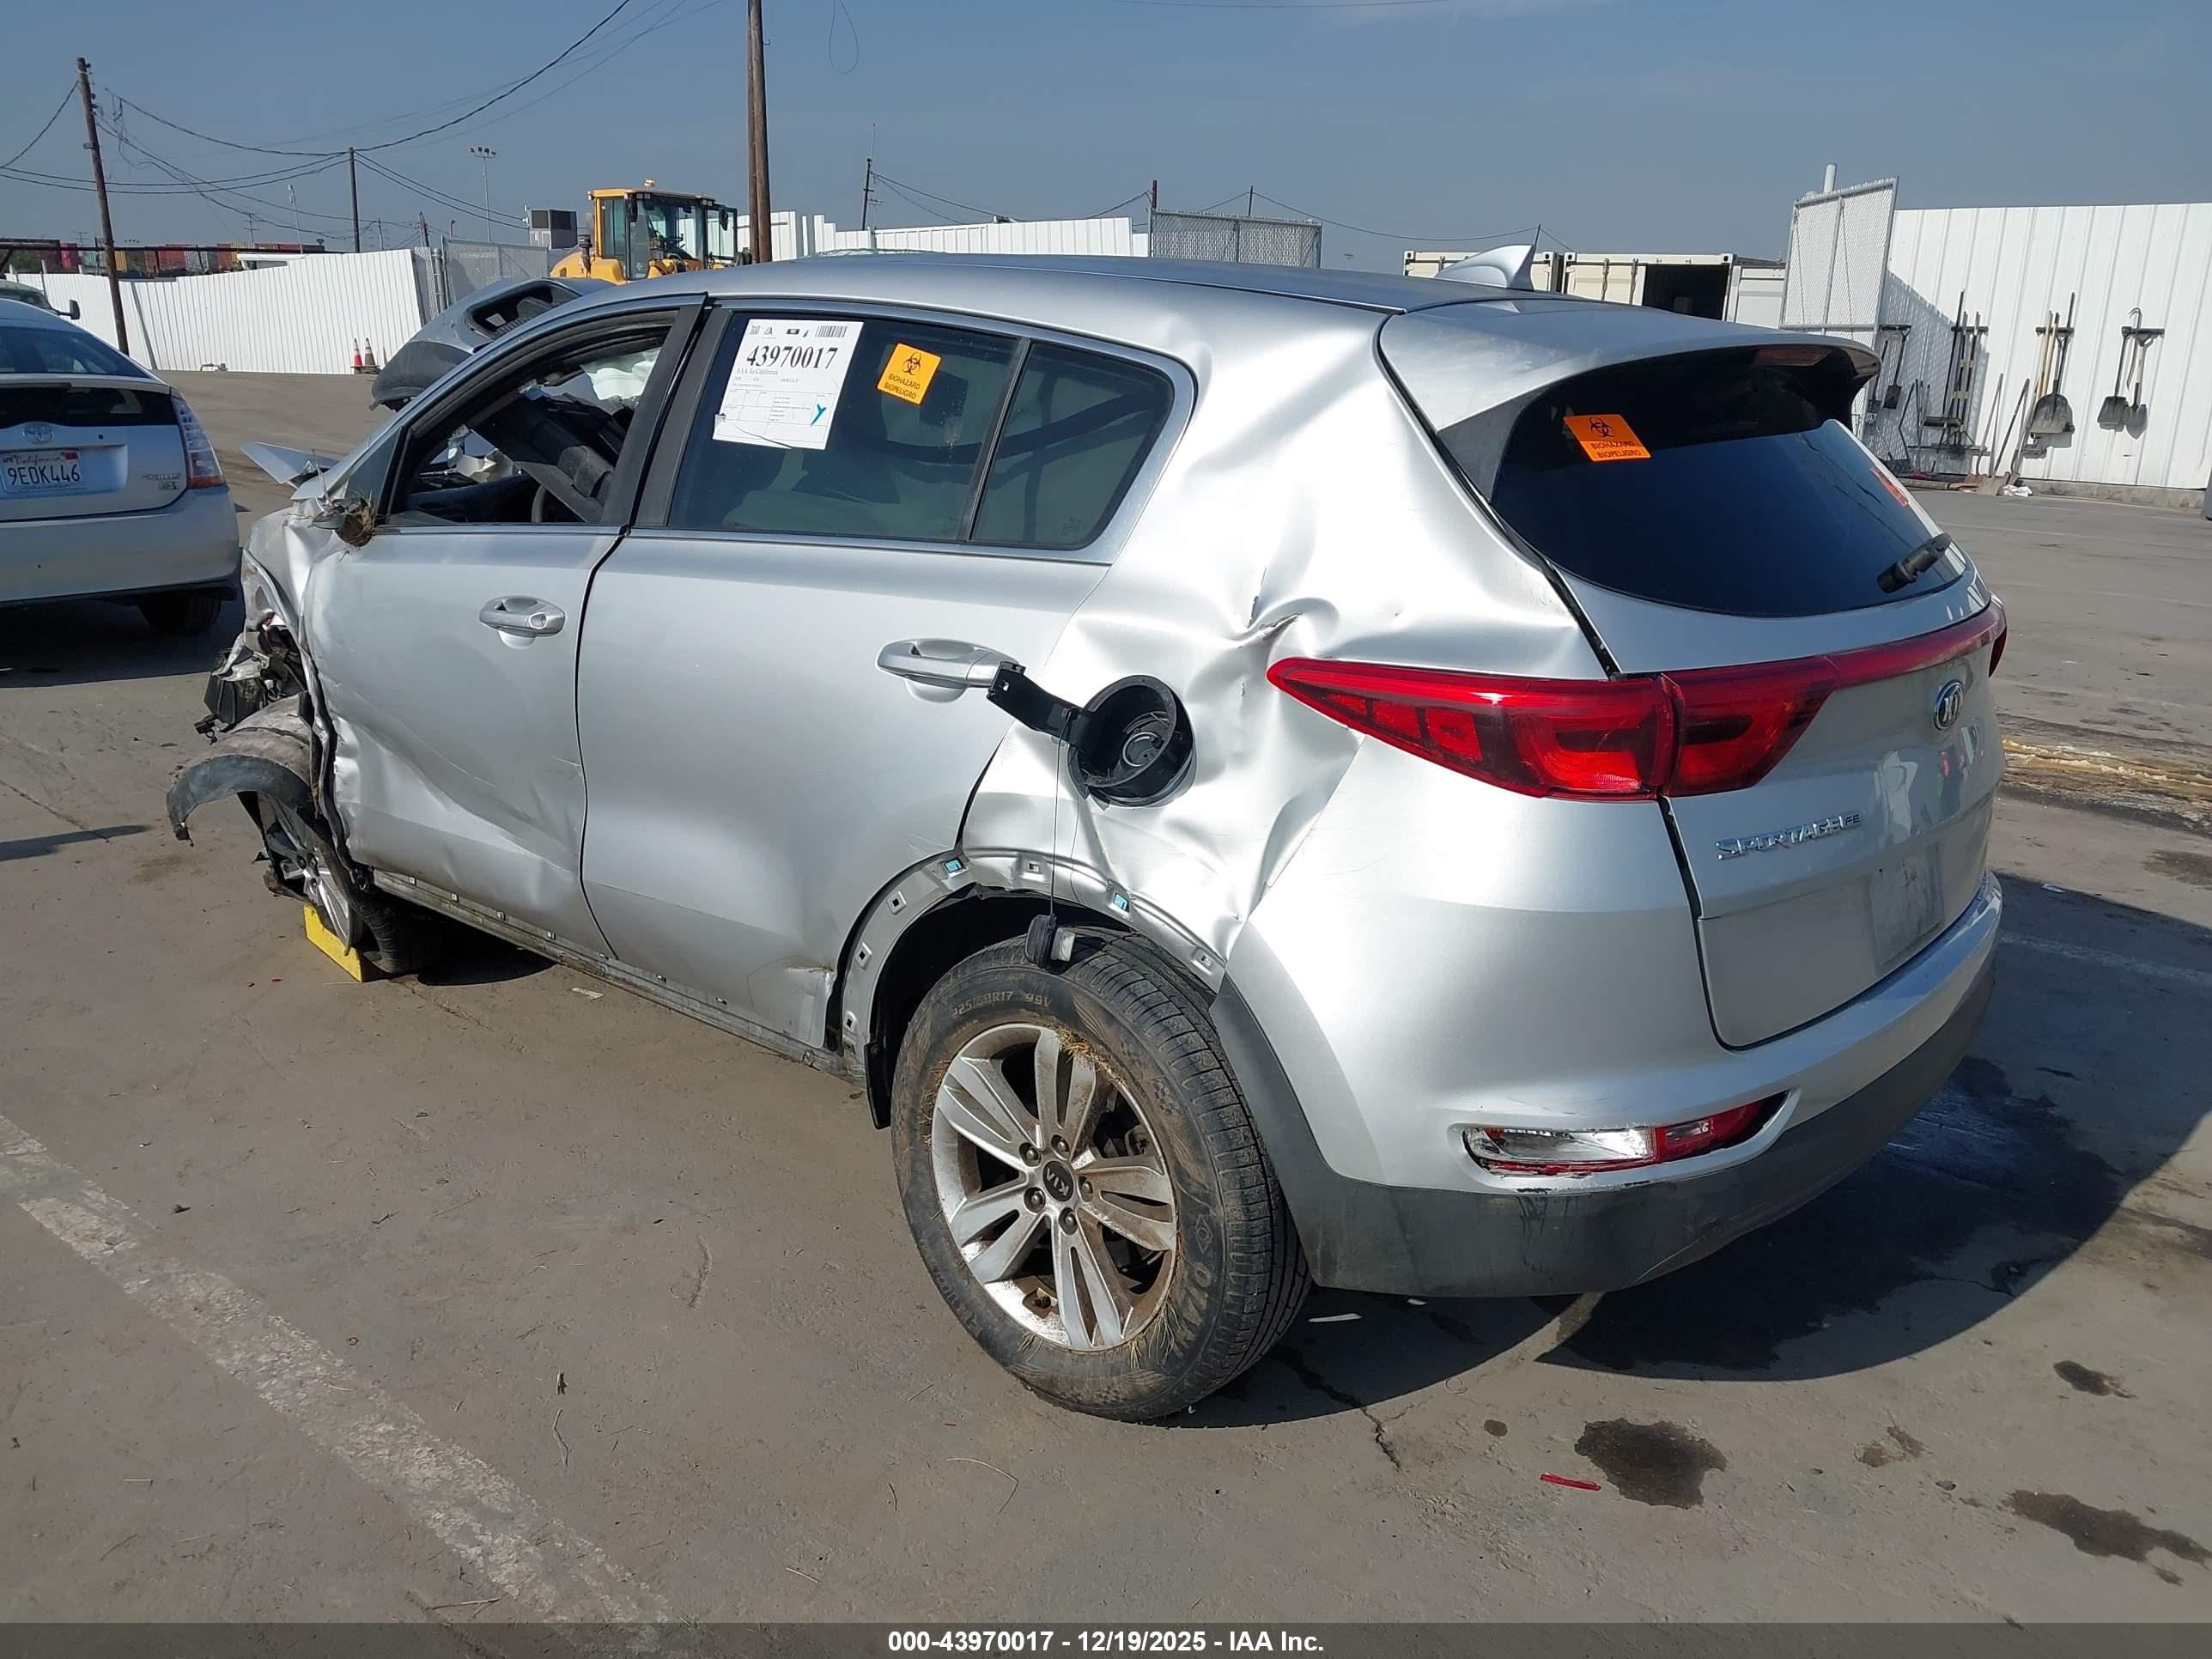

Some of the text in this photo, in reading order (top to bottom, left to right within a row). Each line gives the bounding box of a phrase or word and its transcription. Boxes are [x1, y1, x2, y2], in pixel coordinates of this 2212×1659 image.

[746, 345, 839, 369] 43970017
[884, 381, 917, 399] BIOPELIGRO
[888, 373, 921, 390] BIOHAZARD
[1590, 441, 1635, 449] BIOHAZARD
[1596, 449, 1642, 458] BIOPELIGRO
[1716, 815, 1844, 860] SPORTAGE
[1046, 1167, 1070, 1197] KIA
